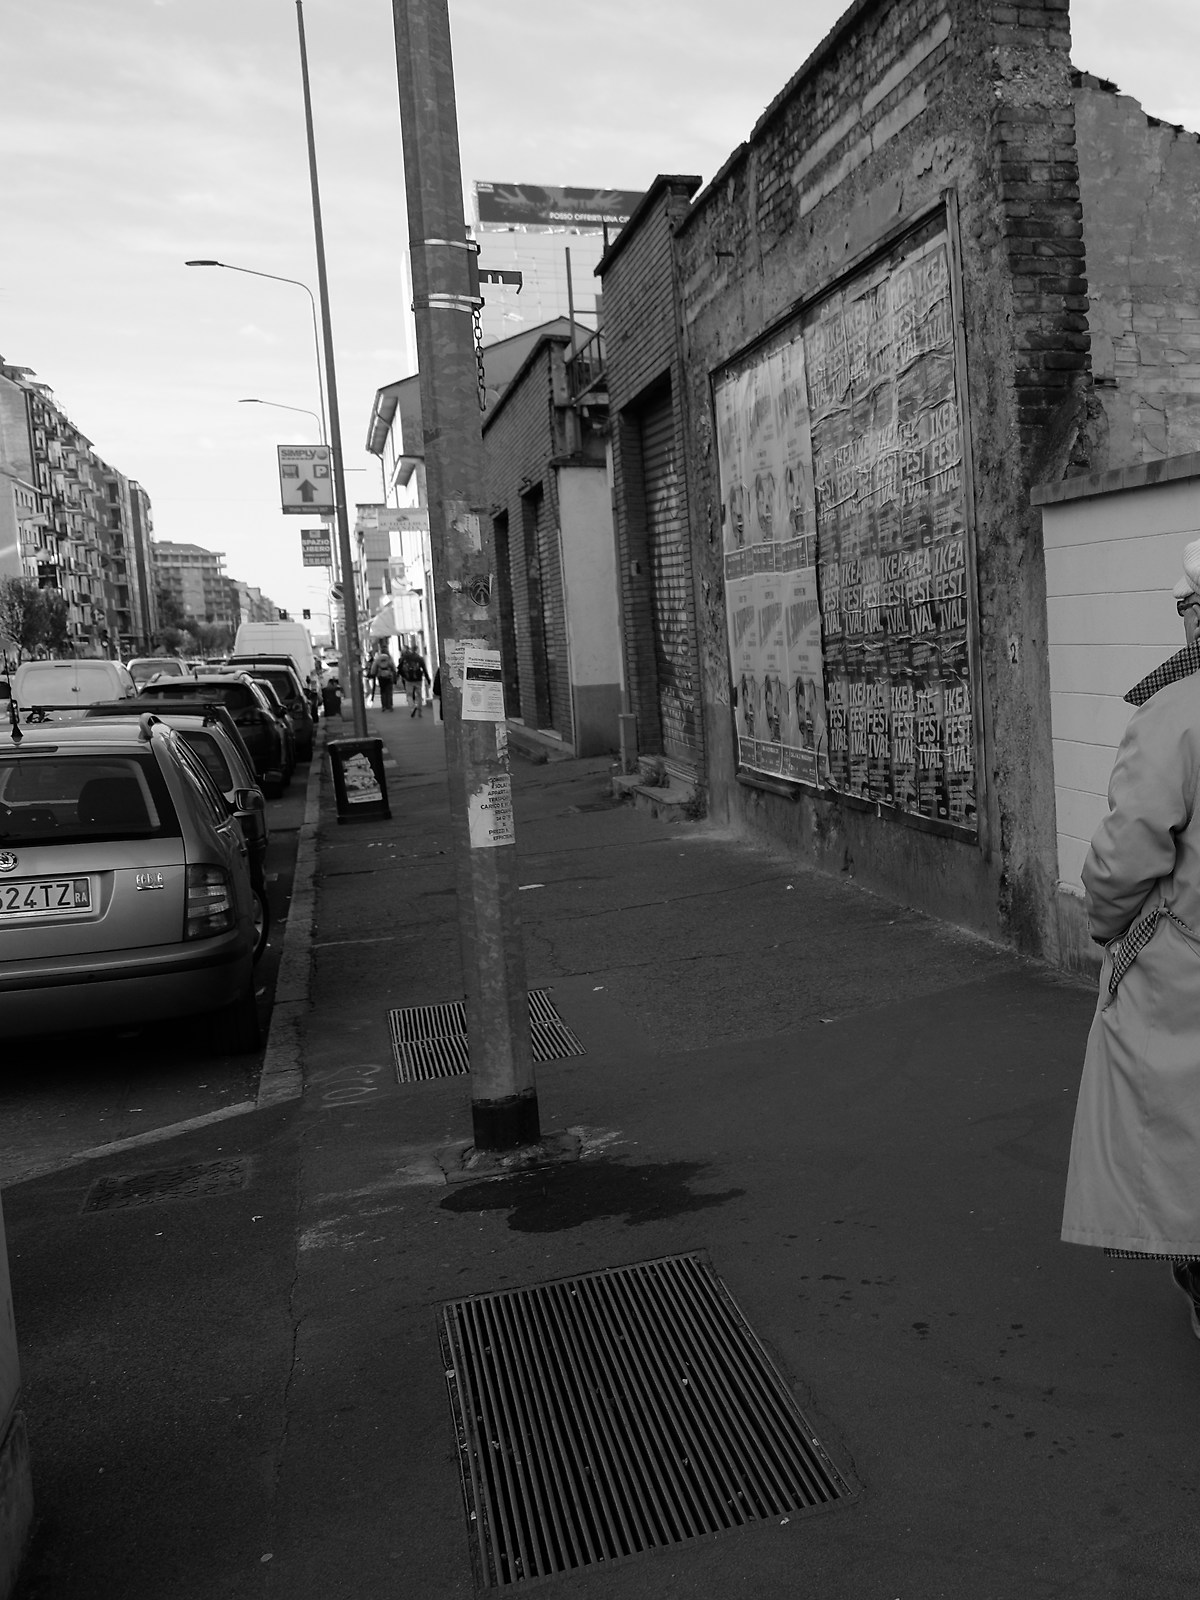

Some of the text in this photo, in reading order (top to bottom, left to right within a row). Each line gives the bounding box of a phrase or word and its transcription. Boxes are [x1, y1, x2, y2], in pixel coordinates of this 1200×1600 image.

[917, 251, 948, 297] IKEA
[281, 449, 316, 459] SIMPLY
[899, 446, 926, 481] FEST
[931, 430, 961, 470] FEST
[315, 466, 327, 477] P
[934, 541, 965, 576] IKEA
[905, 575, 932, 609] FEST
[935, 568, 966, 606] FEST
[825, 610, 842, 636] IVAL
[886, 606, 909, 634] IVAL
[909, 602, 936, 636] IVAL
[939, 600, 966, 632] IVAL
[891, 686, 915, 711] IKEA
[944, 686, 971, 716] IKEA
[829, 707, 847, 729] FEST
[867, 708, 890, 732] FEST
[892, 711, 915, 738] FEST
[917, 715, 941, 743] FEST
[945, 713, 972, 745] FEST
[831, 729, 848, 751] IVAL
[868, 733, 891, 758] IVAL
[894, 737, 917, 764] IVAL
[918, 743, 944, 770] IVAL
[946, 744, 974, 773] IVAL
[0, 884, 71, 910] 24TZ
[75, 892, 87, 903] RA
